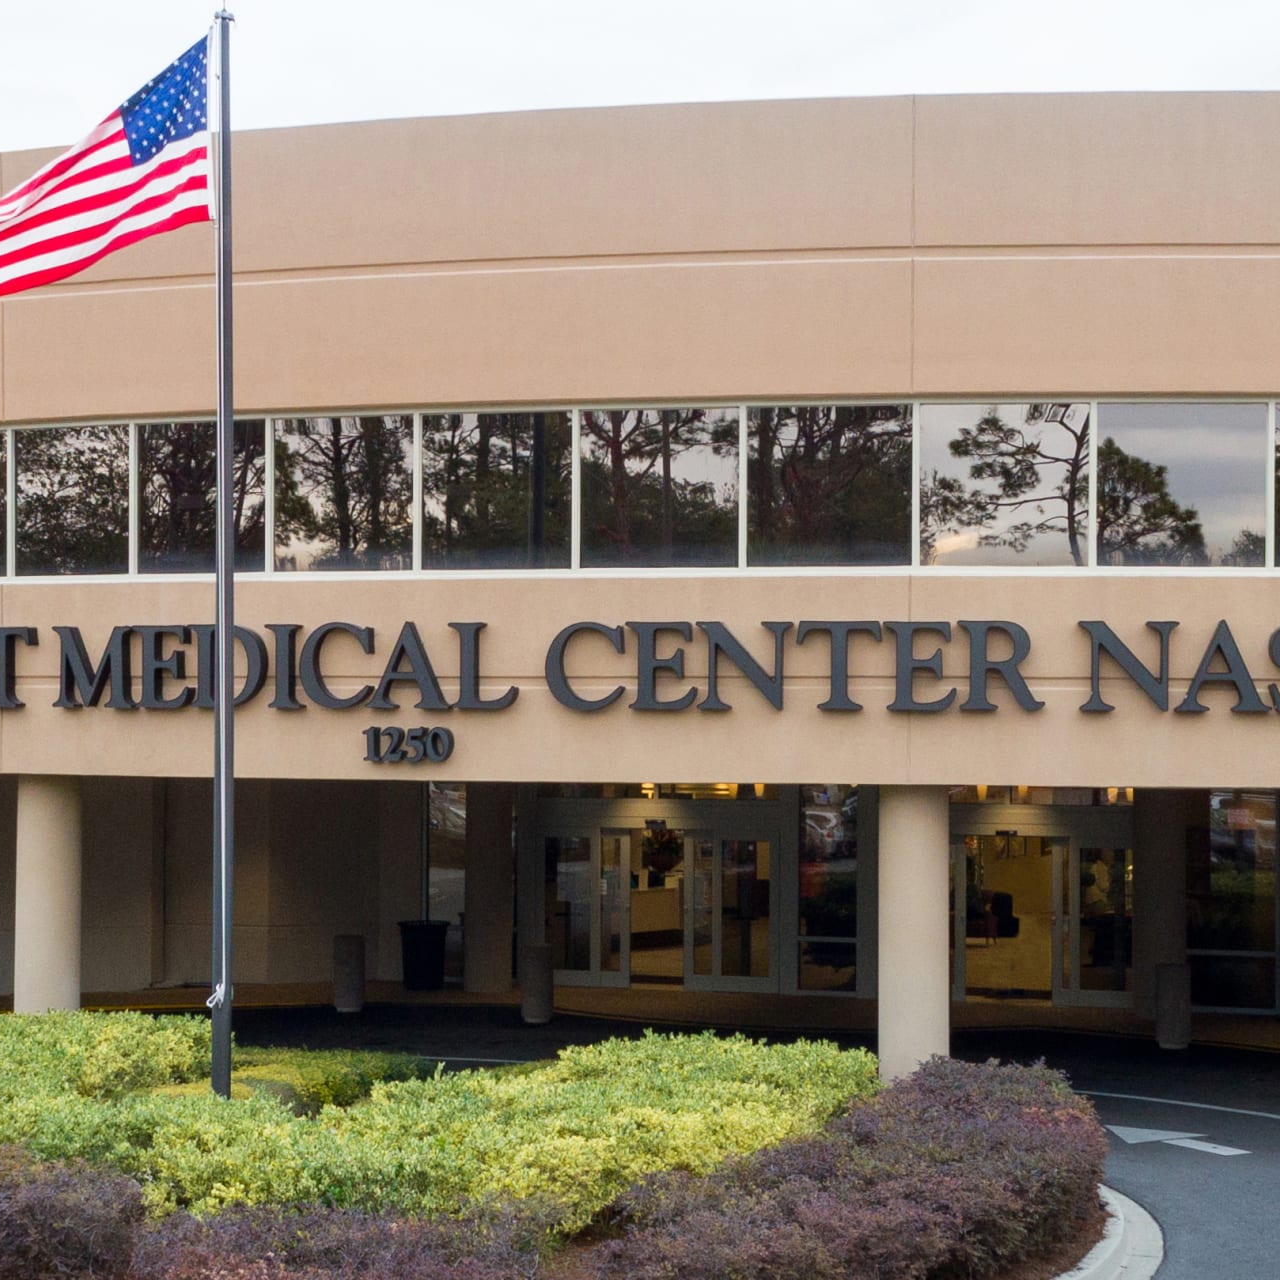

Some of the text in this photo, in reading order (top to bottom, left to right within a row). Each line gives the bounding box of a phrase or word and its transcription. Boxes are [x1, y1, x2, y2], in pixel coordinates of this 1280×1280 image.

[51, 621, 520, 711] MEDICAL
[545, 620, 1046, 713] CENTER
[362, 726, 455, 763] 1250
